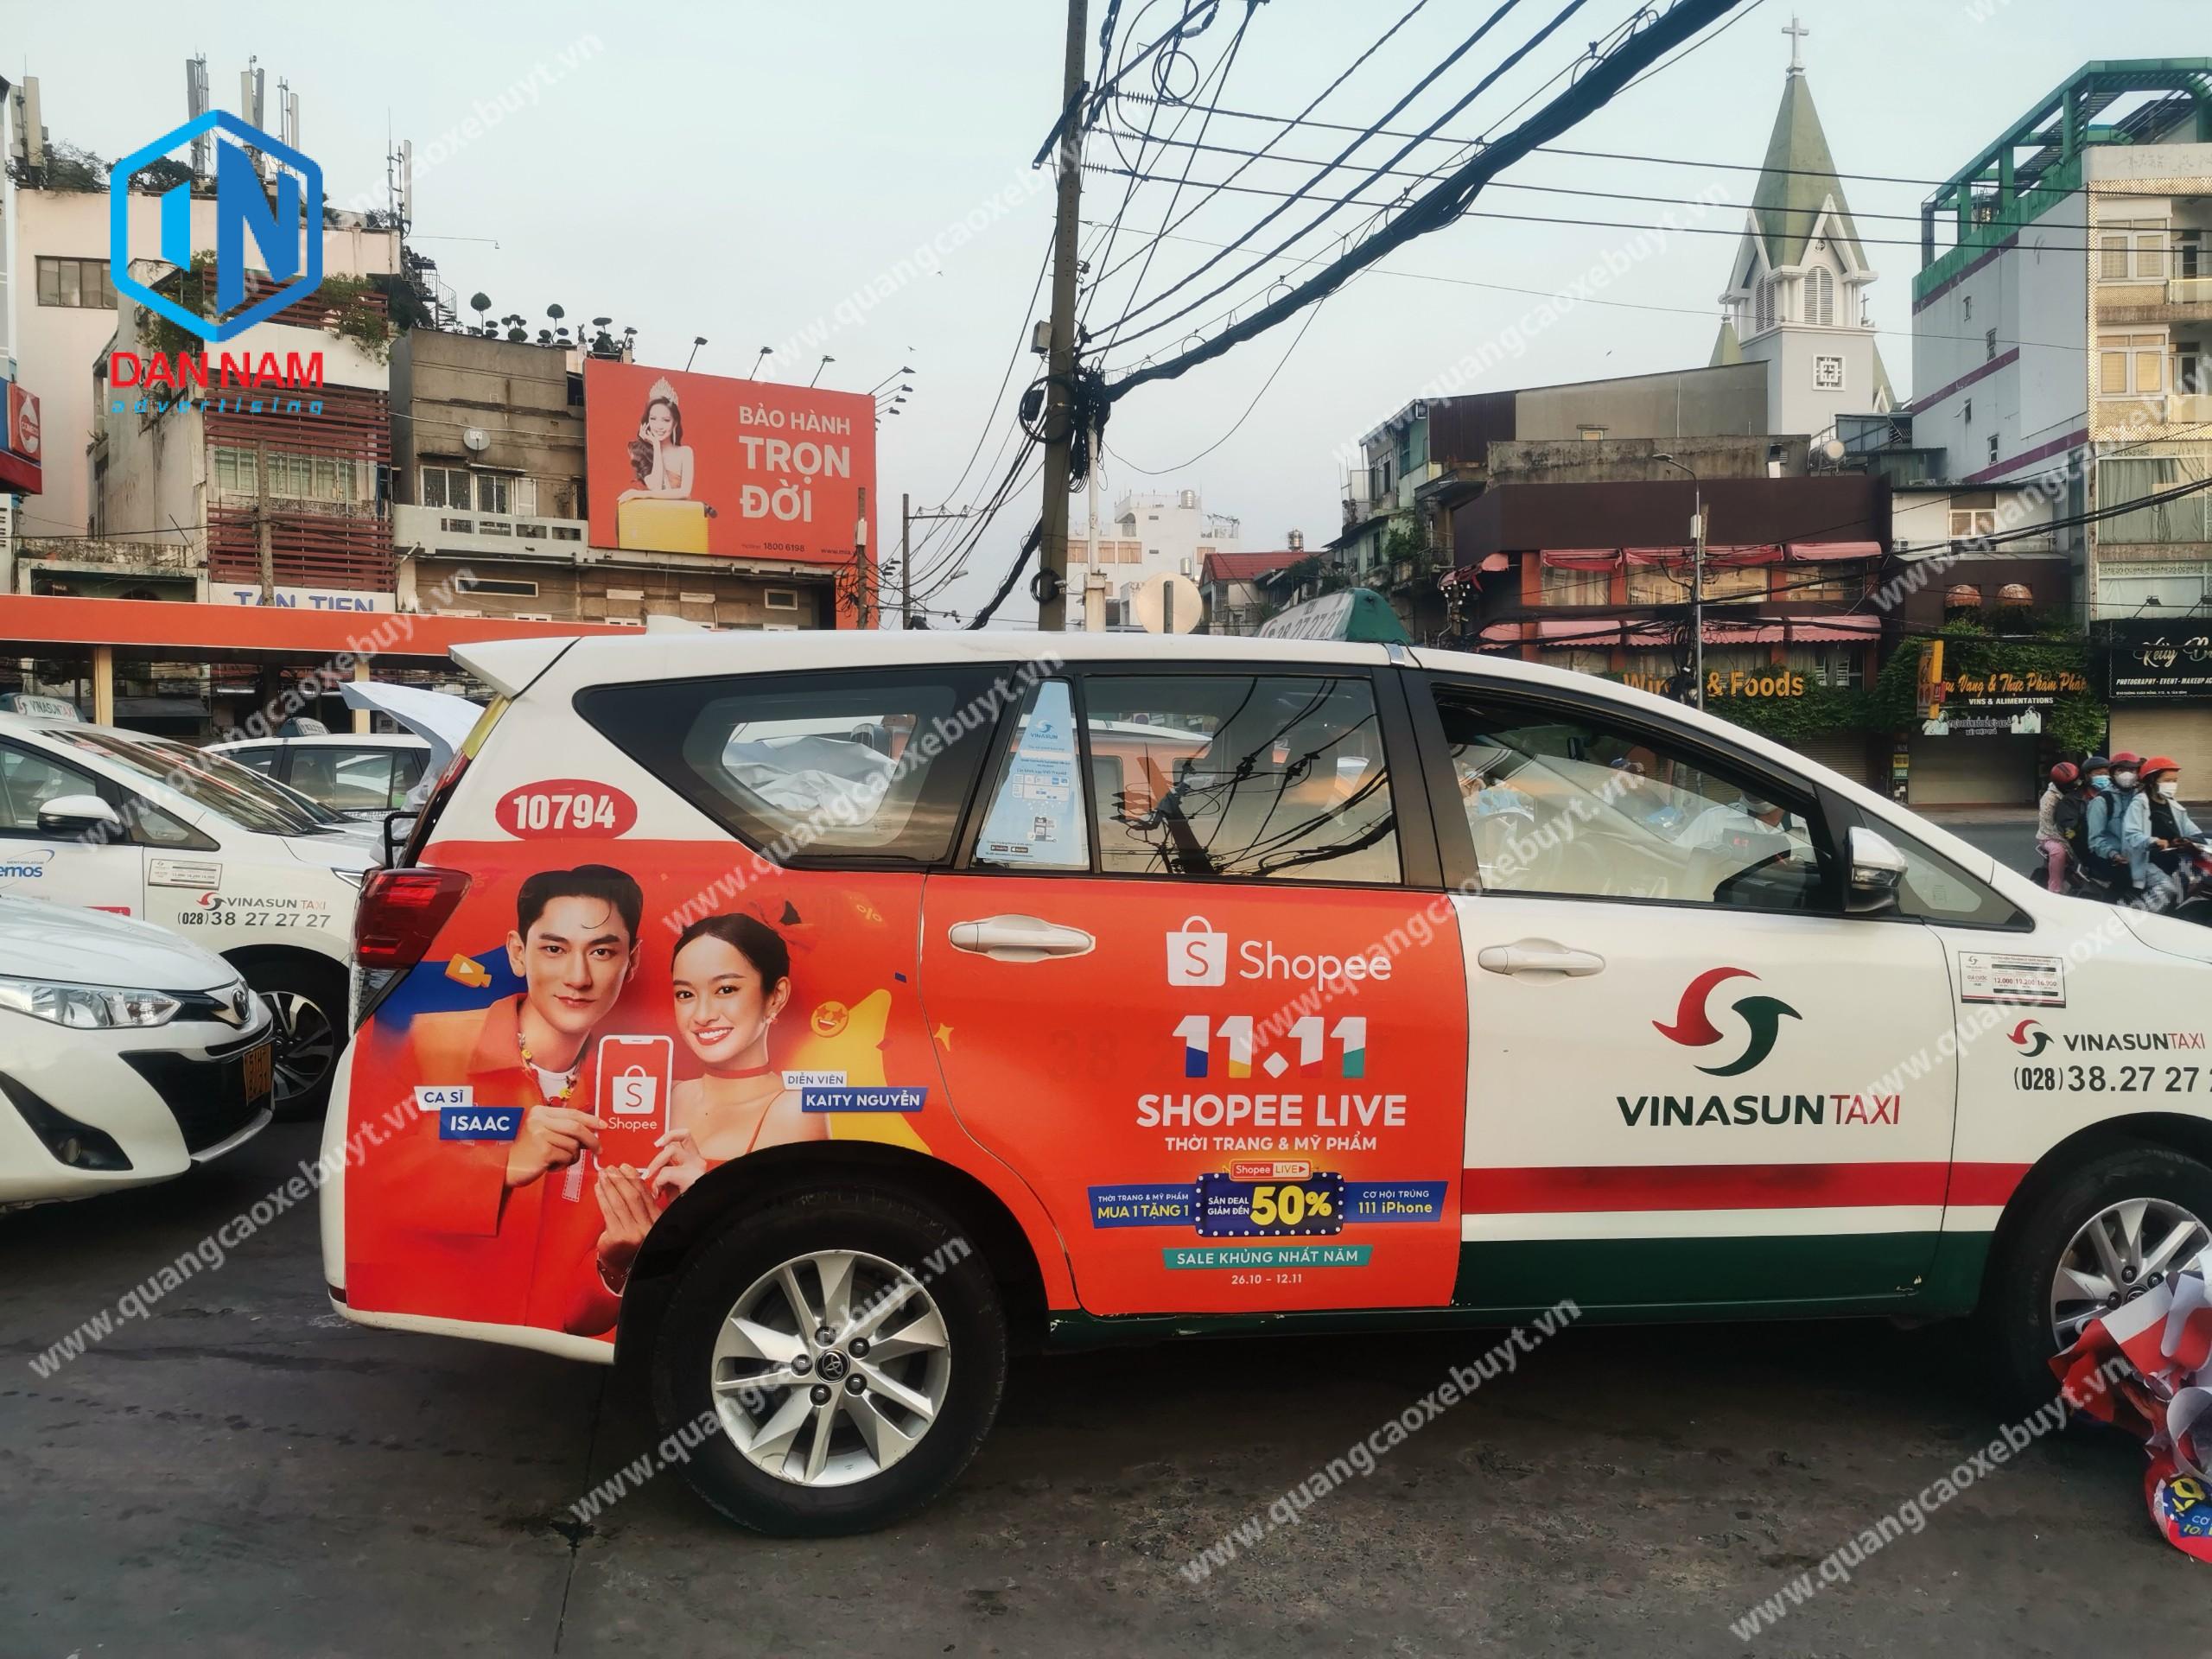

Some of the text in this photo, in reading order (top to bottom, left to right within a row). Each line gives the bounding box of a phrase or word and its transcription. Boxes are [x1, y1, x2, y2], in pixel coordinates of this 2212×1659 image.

[739, 402, 850, 435] BẢO HÀNH
[739, 435, 850, 485] TRỌN
[739, 479, 812, 523] ĐỜI
[764, 542, 784, 551] 1800
[785, 543, 805, 552] 6198
[1707, 671, 1724, 697] &
[1730, 671, 1804, 697] Foods
[1958, 673, 1985, 696] Vang
[1988, 673, 1997, 692] &
[513, 794, 616, 830] 10794
[227, 897, 327, 911] VINASUN TAXI
[245, 912, 270, 926] 27
[275, 913, 301, 927] 27
[306, 914, 331, 928] 27
[1239, 940, 1392, 992] Shopee
[1173, 1014, 1367, 1078] 11.11
[817, 1074, 843, 1084] VIÊN
[423, 1091, 445, 1103] CA
[806, 1094, 852, 1106] KAITY
[1136, 1094, 1407, 1128] SHOPEE LIVE
[450, 1116, 510, 1131] ISAAC
[608, 1116, 658, 1133] Shopee
[1165, 1130, 1376, 1151] THỜI TRANG & MỸ PHẨM
[1236, 1165, 1299, 1177] Shopee LIVE
[1097, 1205, 1129, 1219] MUA
[1133, 1205, 1138, 1217] 1
[1183, 1205, 1189, 1217] 1
[1249, 1185, 1332, 1226] 50%
[1358, 1201, 1433, 1214] 111 iPhone
[1177, 1246, 1358, 1265] SALE KHỦNG NHẤT NĂM
[1231, 1274, 1262, 1285] 26.10
[1276, 1274, 1302, 1284] 12.11
